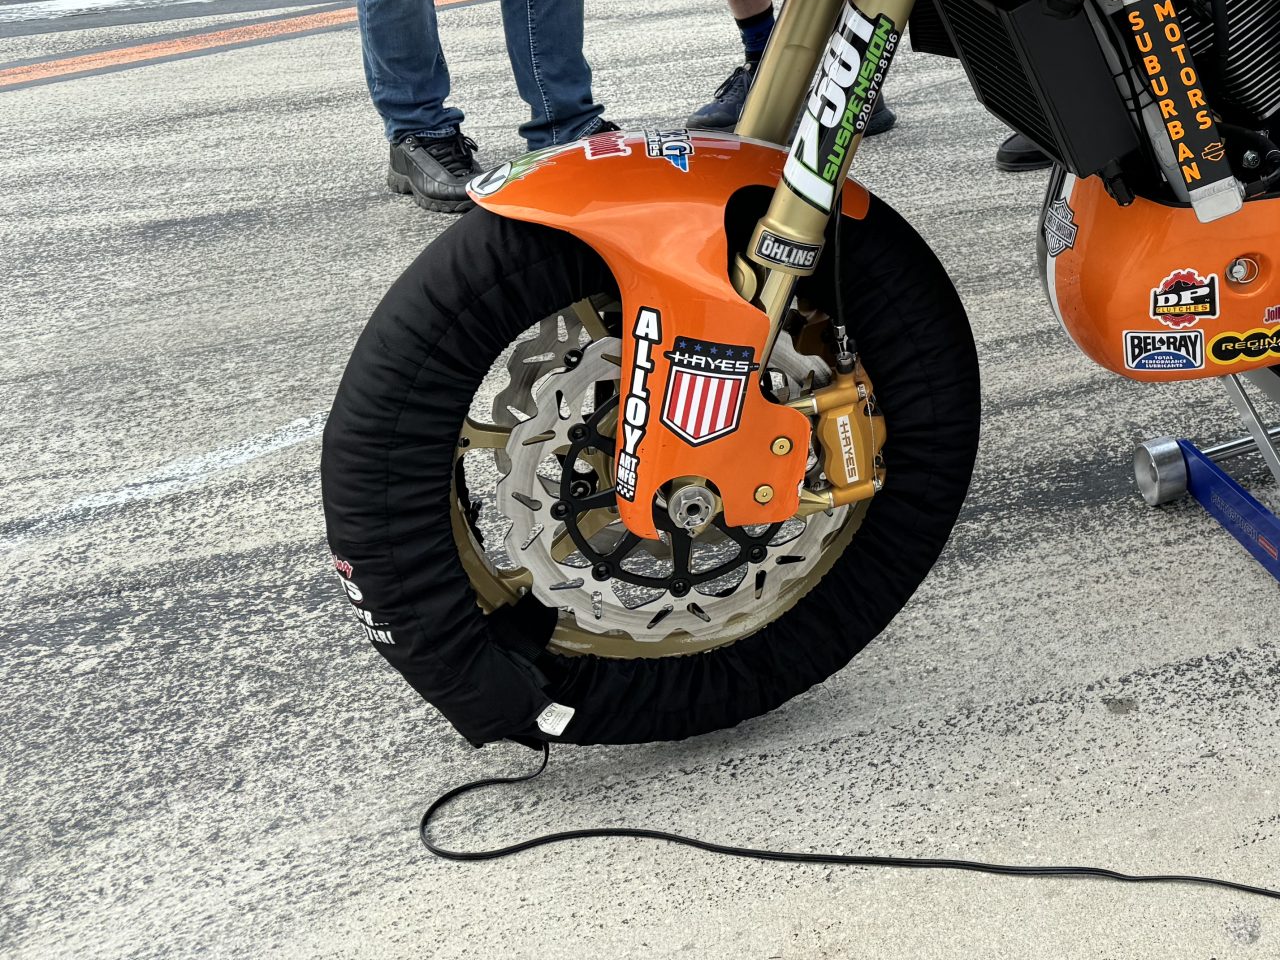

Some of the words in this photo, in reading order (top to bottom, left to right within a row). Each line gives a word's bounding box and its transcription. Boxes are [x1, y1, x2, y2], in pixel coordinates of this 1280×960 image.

[856, 32, 898, 131] 920-979-8156
[823, 16, 892, 184] SUSPENSION
[1128, 10, 1202, 184] SUBURBAN
[761, 237, 817, 266] ÖHLINS
[1156, 285, 1211, 306] DP
[1156, 303, 1210, 314] CLUTCHES
[668, 351, 751, 373] HAYES
[624, 309, 660, 455] ALLOY
[620, 452, 638, 471] ART
[839, 420, 857, 480] HAYES
[617, 464, 636, 486] MFG
